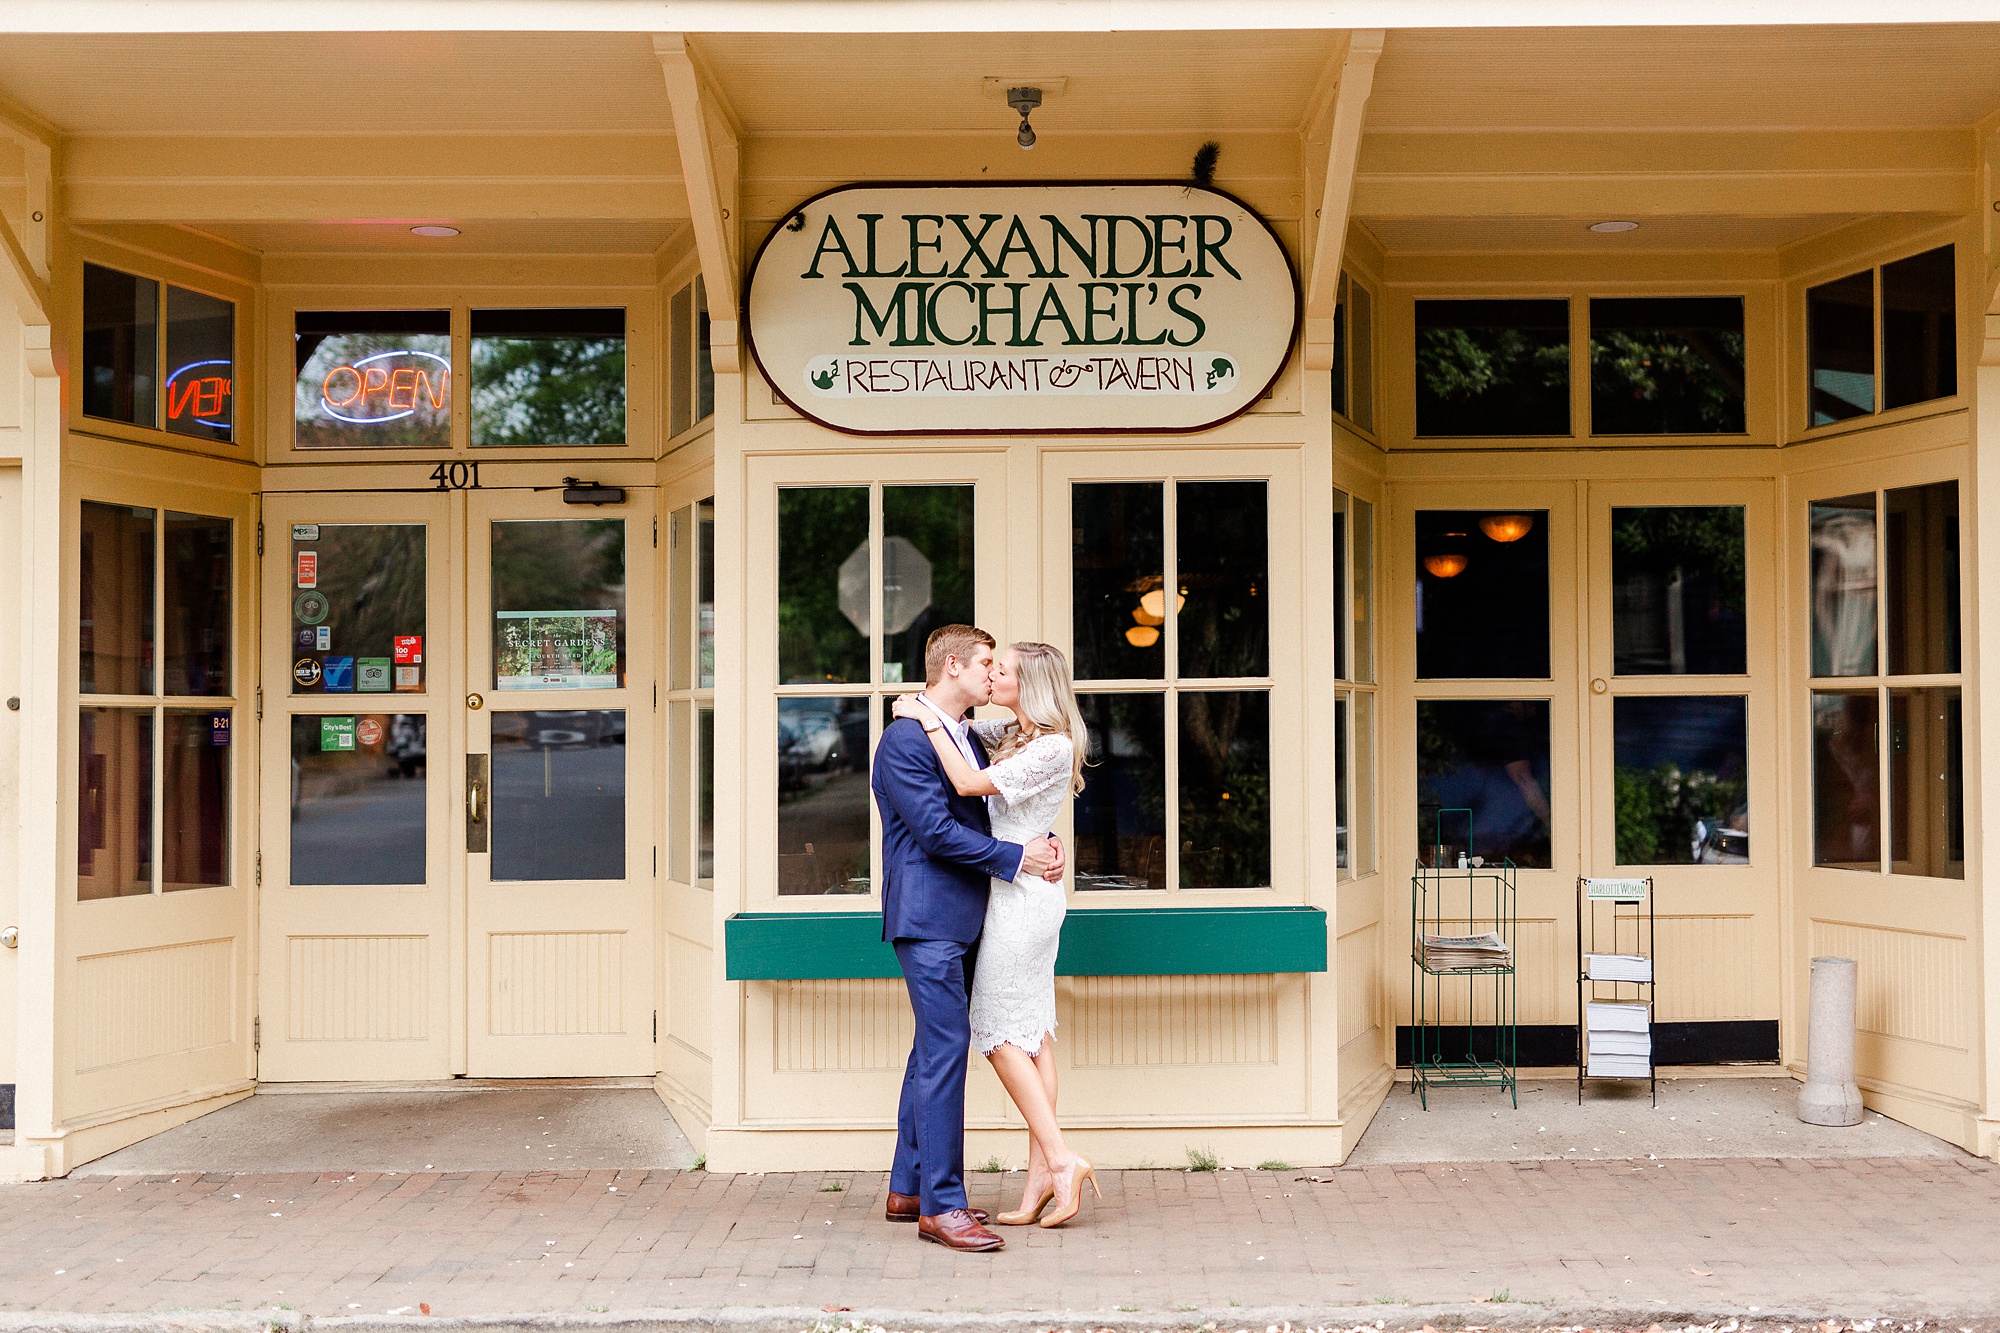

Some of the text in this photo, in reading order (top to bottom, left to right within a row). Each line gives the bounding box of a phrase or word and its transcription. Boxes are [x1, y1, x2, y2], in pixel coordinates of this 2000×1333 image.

[801, 214, 1242, 281] ALEXANDER
[842, 281, 1207, 347] MICHAEL'S
[323, 365, 448, 409] OPEN
[846, 357, 1195, 394] RESTAURANT & TAVERN
[429, 461, 482, 489] 401
[508, 638, 606, 648] SECRET GARDENS
